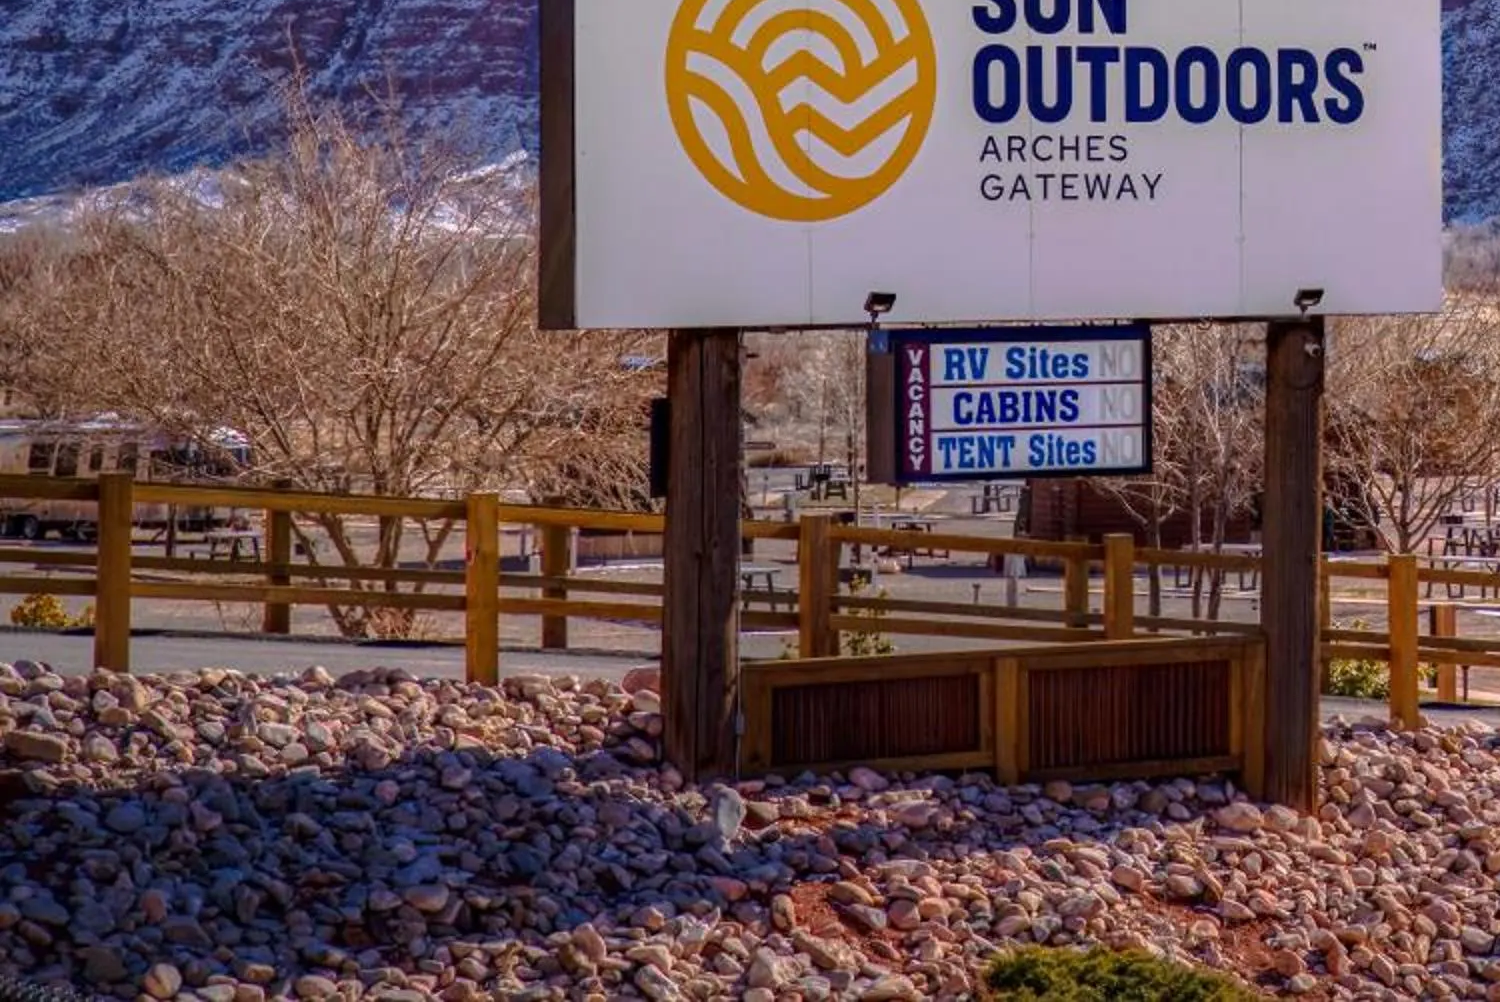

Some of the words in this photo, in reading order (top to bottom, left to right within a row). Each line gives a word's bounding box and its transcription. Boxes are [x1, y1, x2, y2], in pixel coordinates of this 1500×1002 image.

[972, 43, 1365, 125] OUTDOORS
[979, 135, 1129, 162] ARCHES
[979, 173, 1164, 201] GATEWAY
[943, 348, 989, 380] RV
[1005, 347, 1089, 379] Sites
[1099, 344, 1137, 378] NO
[906, 349, 925, 471] VACANCY
[953, 389, 1079, 425] CABINS
[1100, 387, 1137, 421] NO
[938, 436, 1015, 469] TENT
[1028, 434, 1097, 467] Sites
[1101, 432, 1137, 465] NO
